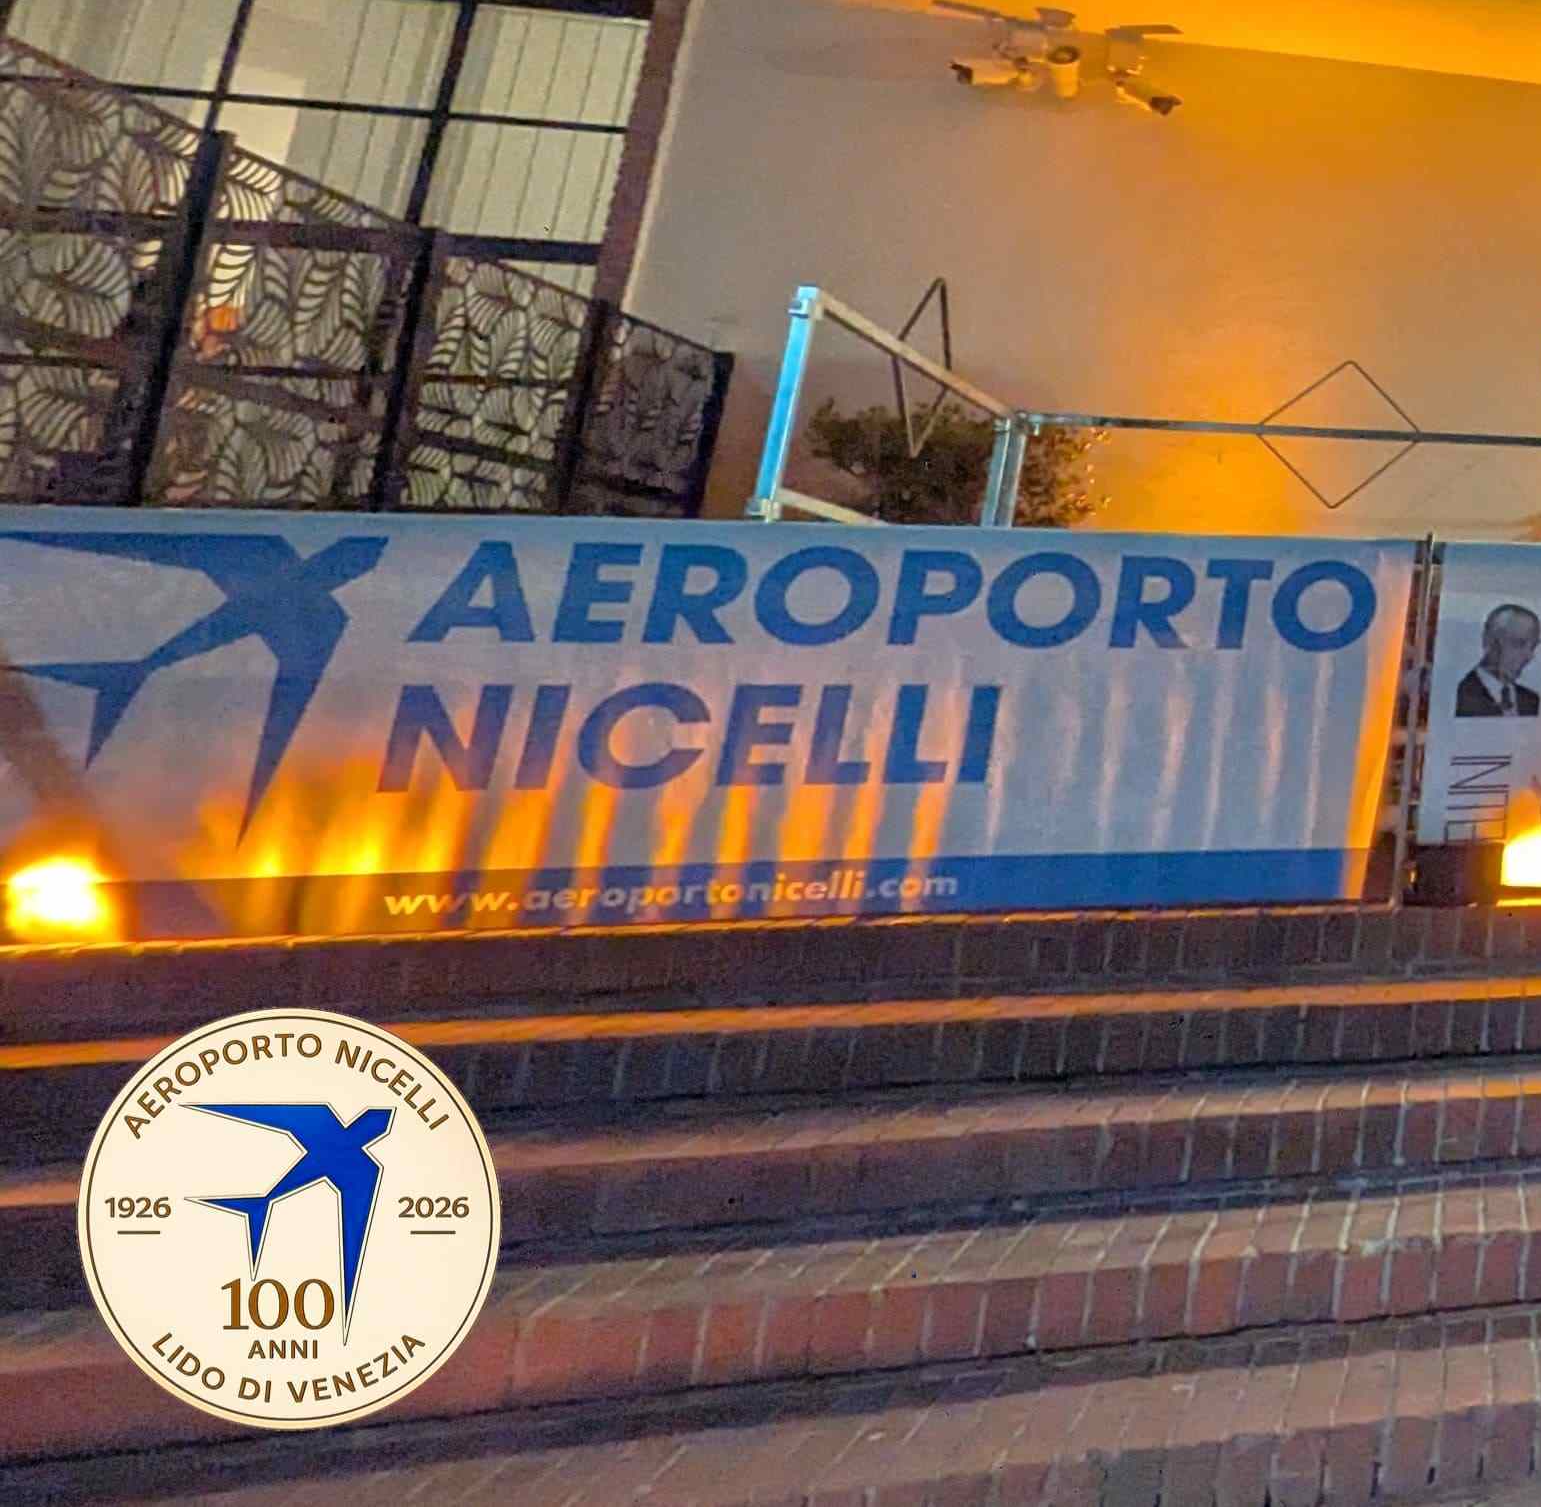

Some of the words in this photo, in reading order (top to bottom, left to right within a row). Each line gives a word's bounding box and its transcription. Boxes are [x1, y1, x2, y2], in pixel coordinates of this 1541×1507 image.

[405, 540, 1377, 652] AEROPORTO
[377, 682, 1004, 793] NICELLI
[384, 870, 958, 917] www.aeroportonicelli.com
